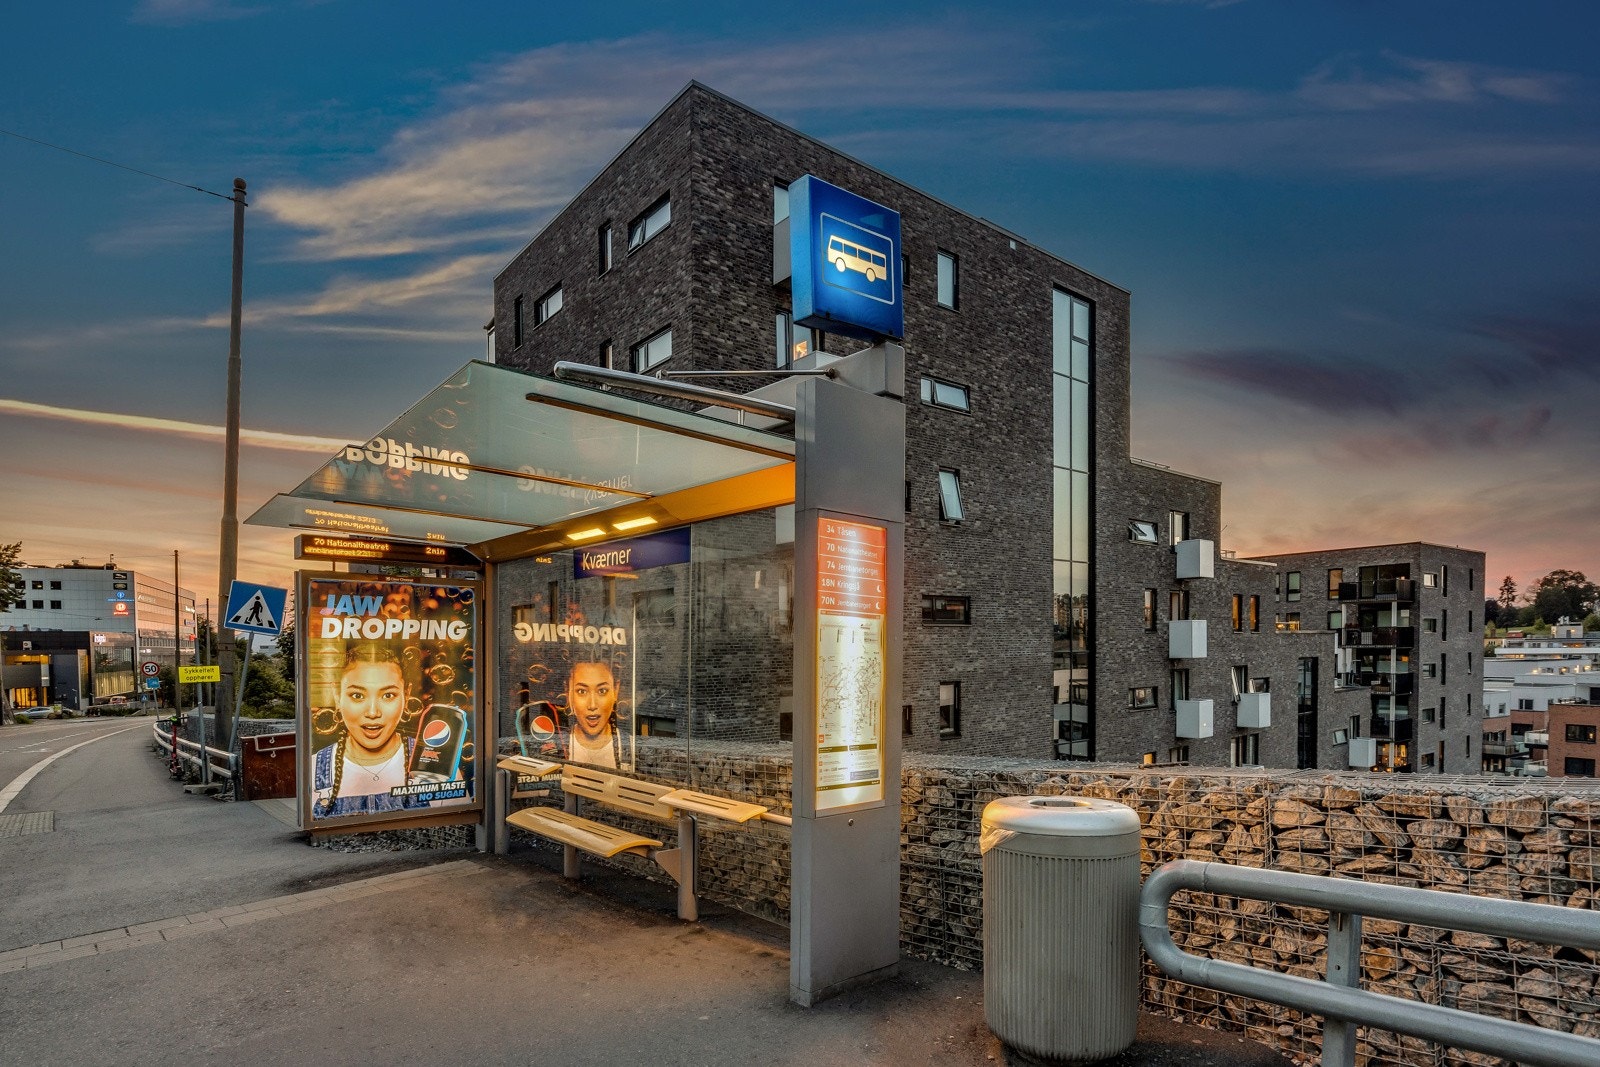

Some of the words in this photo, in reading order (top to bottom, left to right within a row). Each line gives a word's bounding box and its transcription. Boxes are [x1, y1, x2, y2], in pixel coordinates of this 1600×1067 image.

[827, 525, 835, 533] 34
[327, 539, 389, 551] Nationaltheatret
[426, 547, 446, 555] 2min
[826, 543, 835, 551] 70
[582, 548, 632, 571] Kværner
[826, 560, 836, 569] 74
[821, 579, 835, 587] 18N
[320, 594, 383, 616] JAW
[821, 596, 835, 605] 70N
[321, 617, 468, 641] DROPPING
[144, 665, 156, 673] 50
[392, 783, 439, 796] MAXIMUM
[440, 780, 466, 791] TASTE
[418, 792, 433, 801] NO
[434, 789, 465, 799] SUGAR
